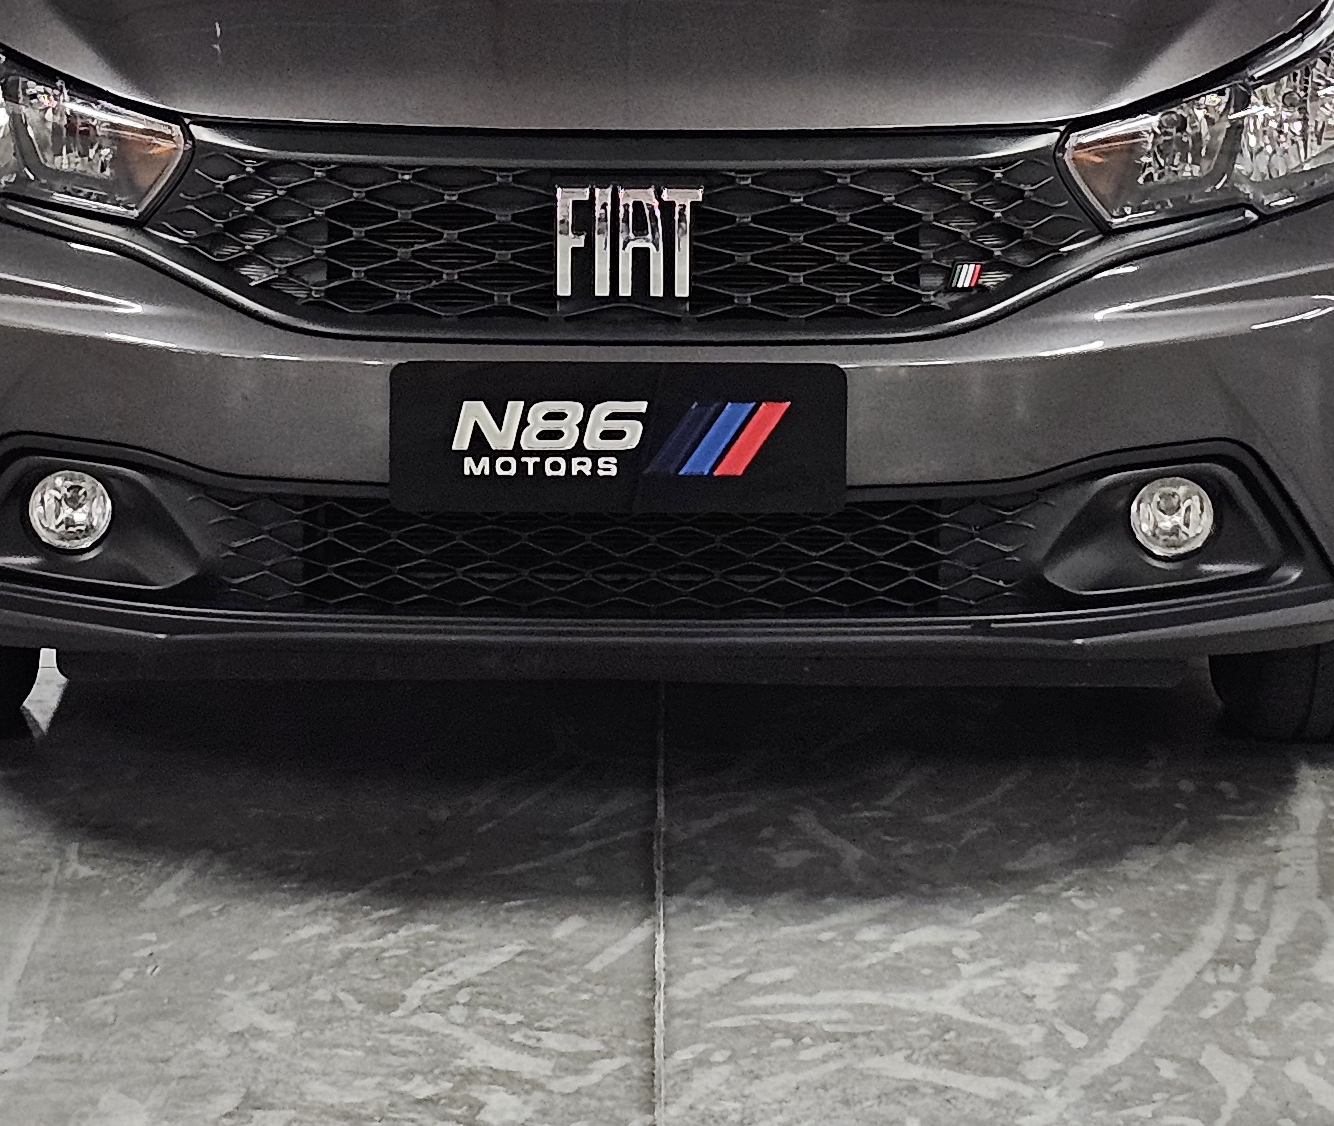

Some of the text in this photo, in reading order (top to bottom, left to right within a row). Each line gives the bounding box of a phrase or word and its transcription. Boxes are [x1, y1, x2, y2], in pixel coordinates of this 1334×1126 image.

[556, 186, 703, 297] FIAT
[452, 401, 648, 450] N86
[464, 457, 617, 476] MOTORS
